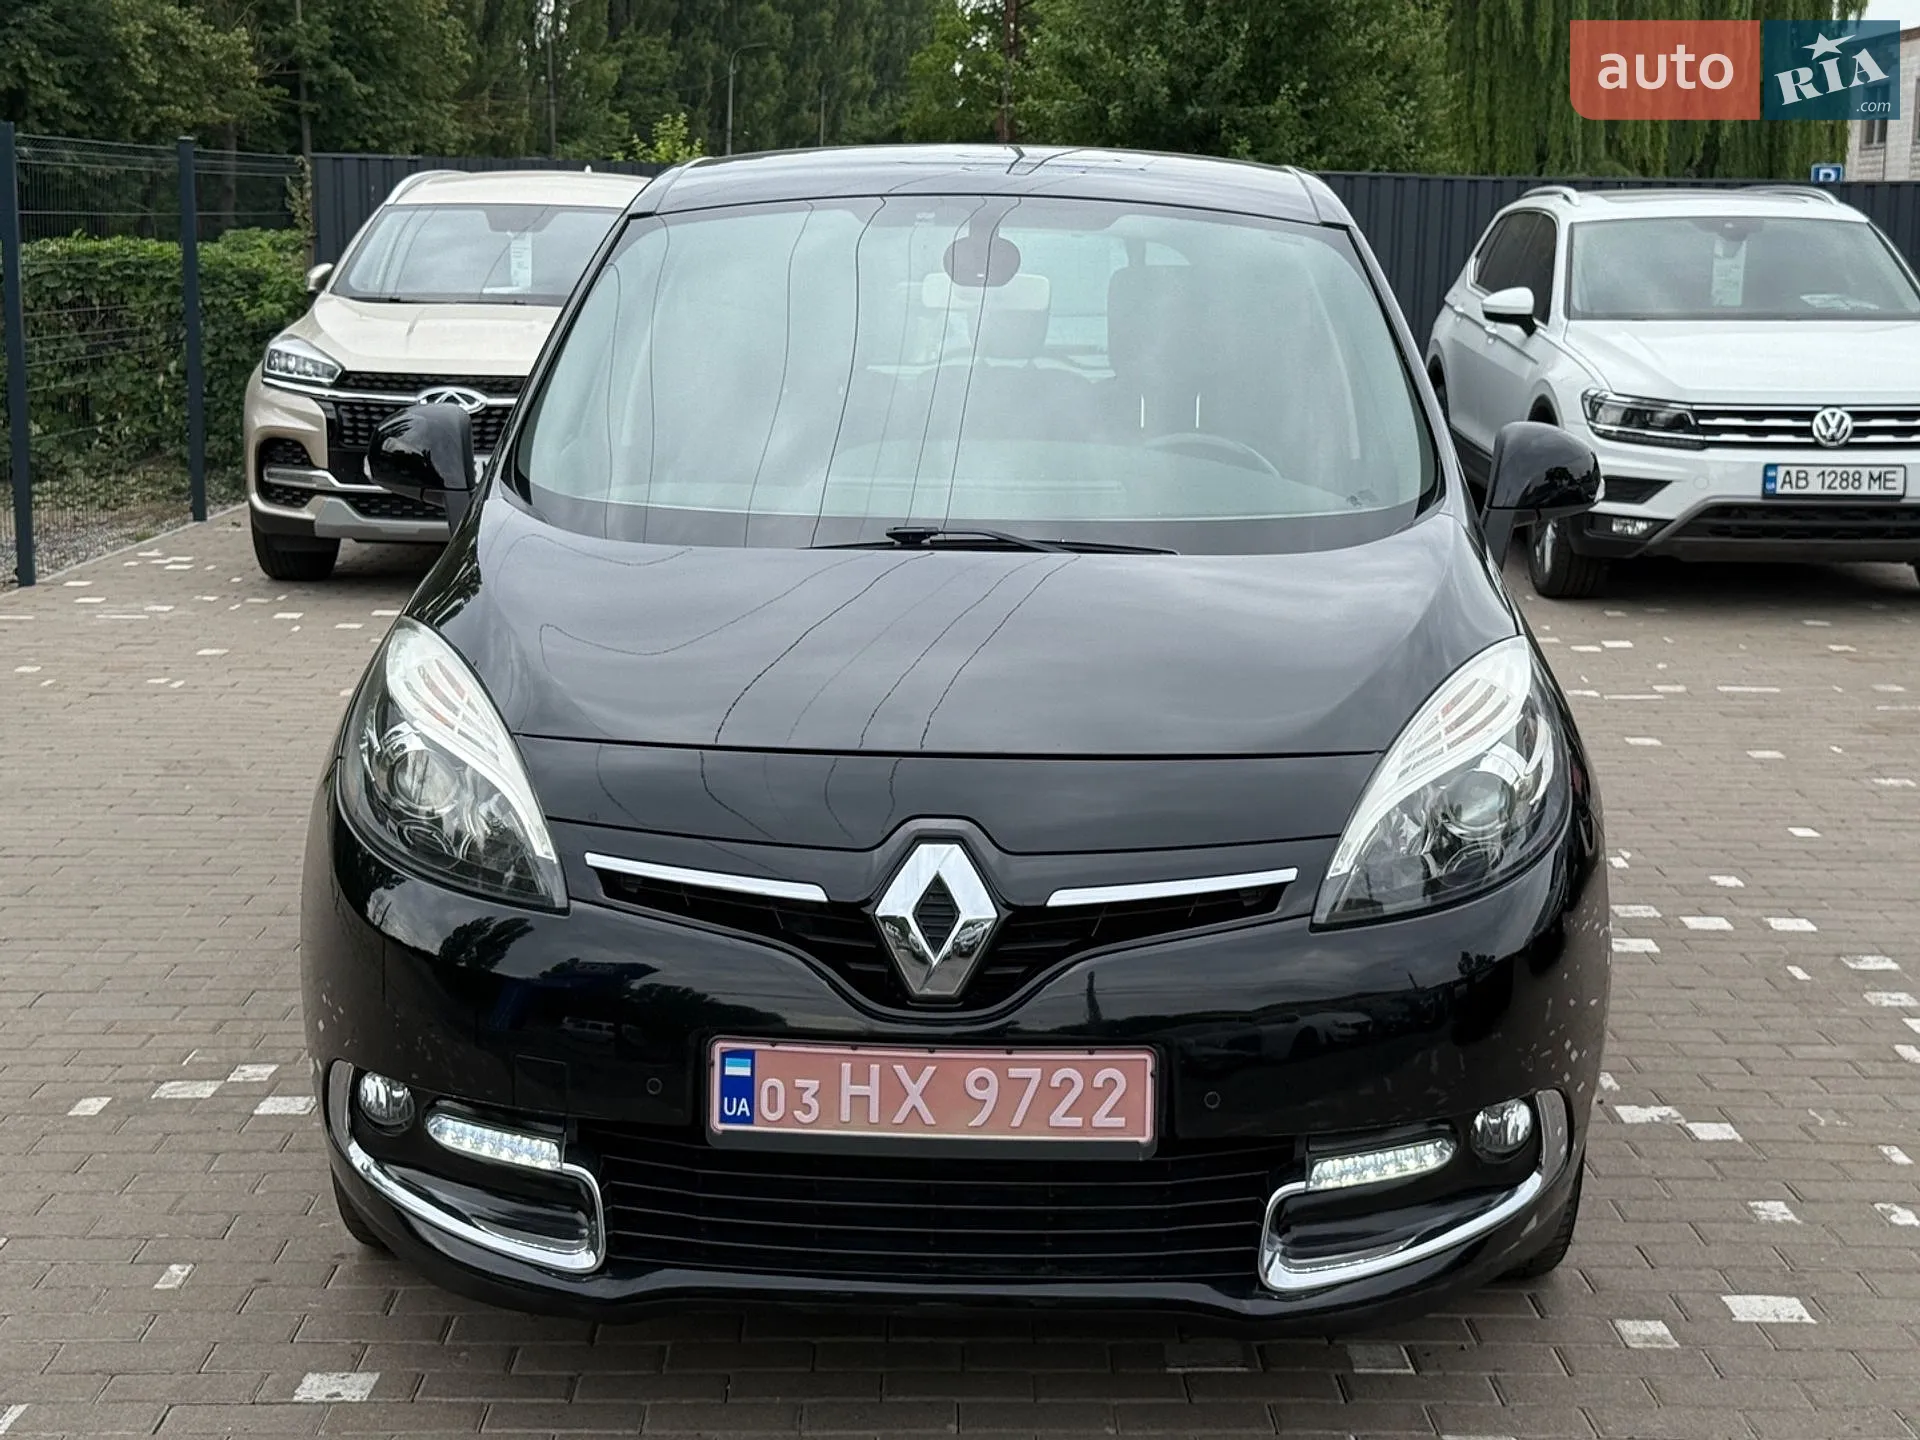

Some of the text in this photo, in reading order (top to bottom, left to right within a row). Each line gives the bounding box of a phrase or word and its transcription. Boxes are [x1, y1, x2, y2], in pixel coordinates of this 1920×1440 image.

[1780, 469, 1897, 490] AB 1288 ME
[759, 1062, 1128, 1128] 03 HX 9722
[724, 1096, 750, 1117] UA
